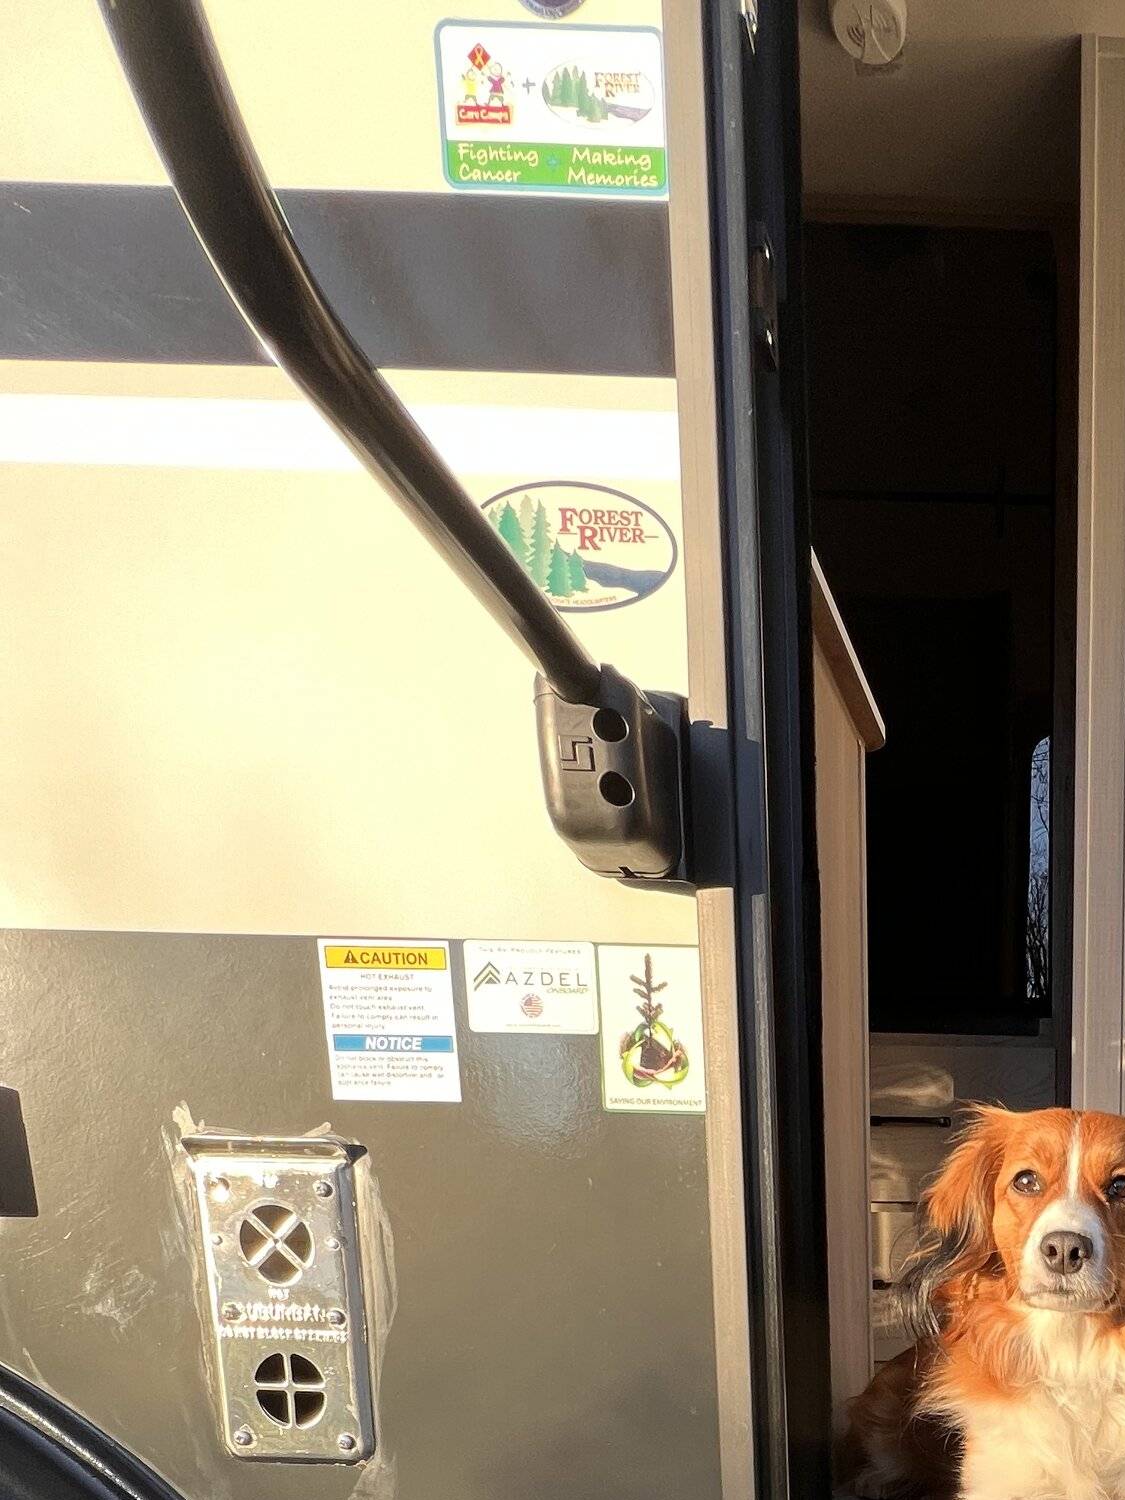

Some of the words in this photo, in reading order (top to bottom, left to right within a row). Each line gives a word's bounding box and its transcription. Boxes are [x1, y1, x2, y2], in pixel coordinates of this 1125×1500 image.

[594, 72, 641, 87] FOREST
[605, 82, 640, 97] RIVER
[457, 143, 539, 167] Fighting
[572, 147, 652, 170] Making
[459, 163, 522, 182] Cancer
[567, 167, 658, 187] Memories
[558, 507, 643, 533] FOREST
[577, 525, 646, 551] RIVER
[360, 952, 428, 965] CAUTION
[504, 971, 588, 987] AZDEL
[365, 1036, 423, 1051] NOTICE
